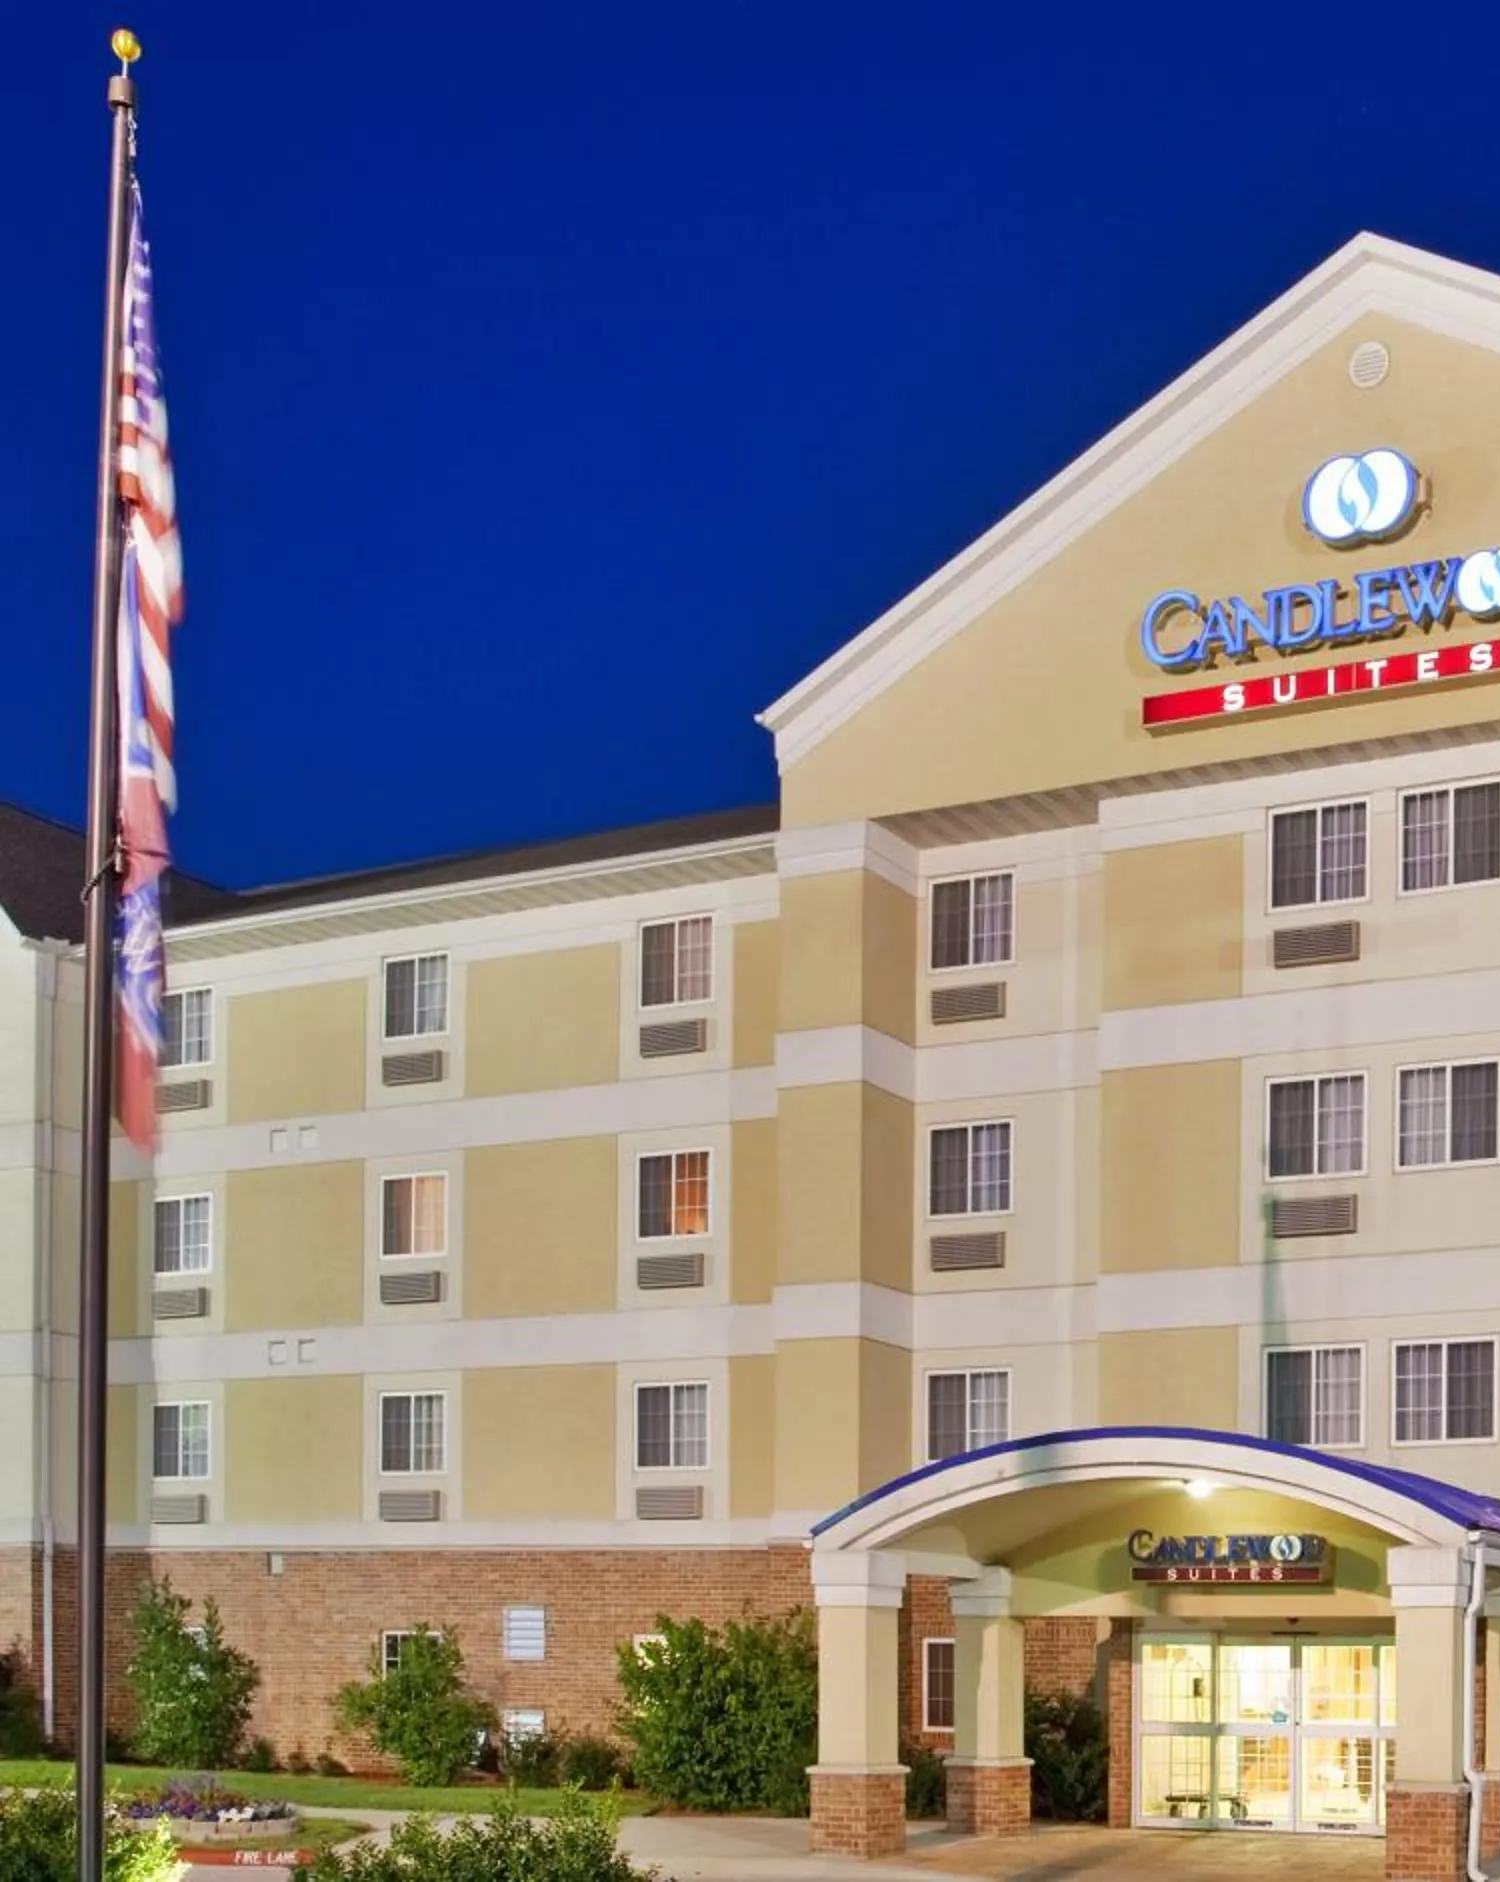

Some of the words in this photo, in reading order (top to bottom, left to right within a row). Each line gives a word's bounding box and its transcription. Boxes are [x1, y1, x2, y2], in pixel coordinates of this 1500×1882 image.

[1222, 643, 1494, 712] SUITES
[1128, 1529, 1327, 1562] CANDLEWOOD
[1167, 1567, 1284, 1581] SUITES
[234, 1850, 264, 1865] FIRE
[267, 1850, 298, 1865] LANE
